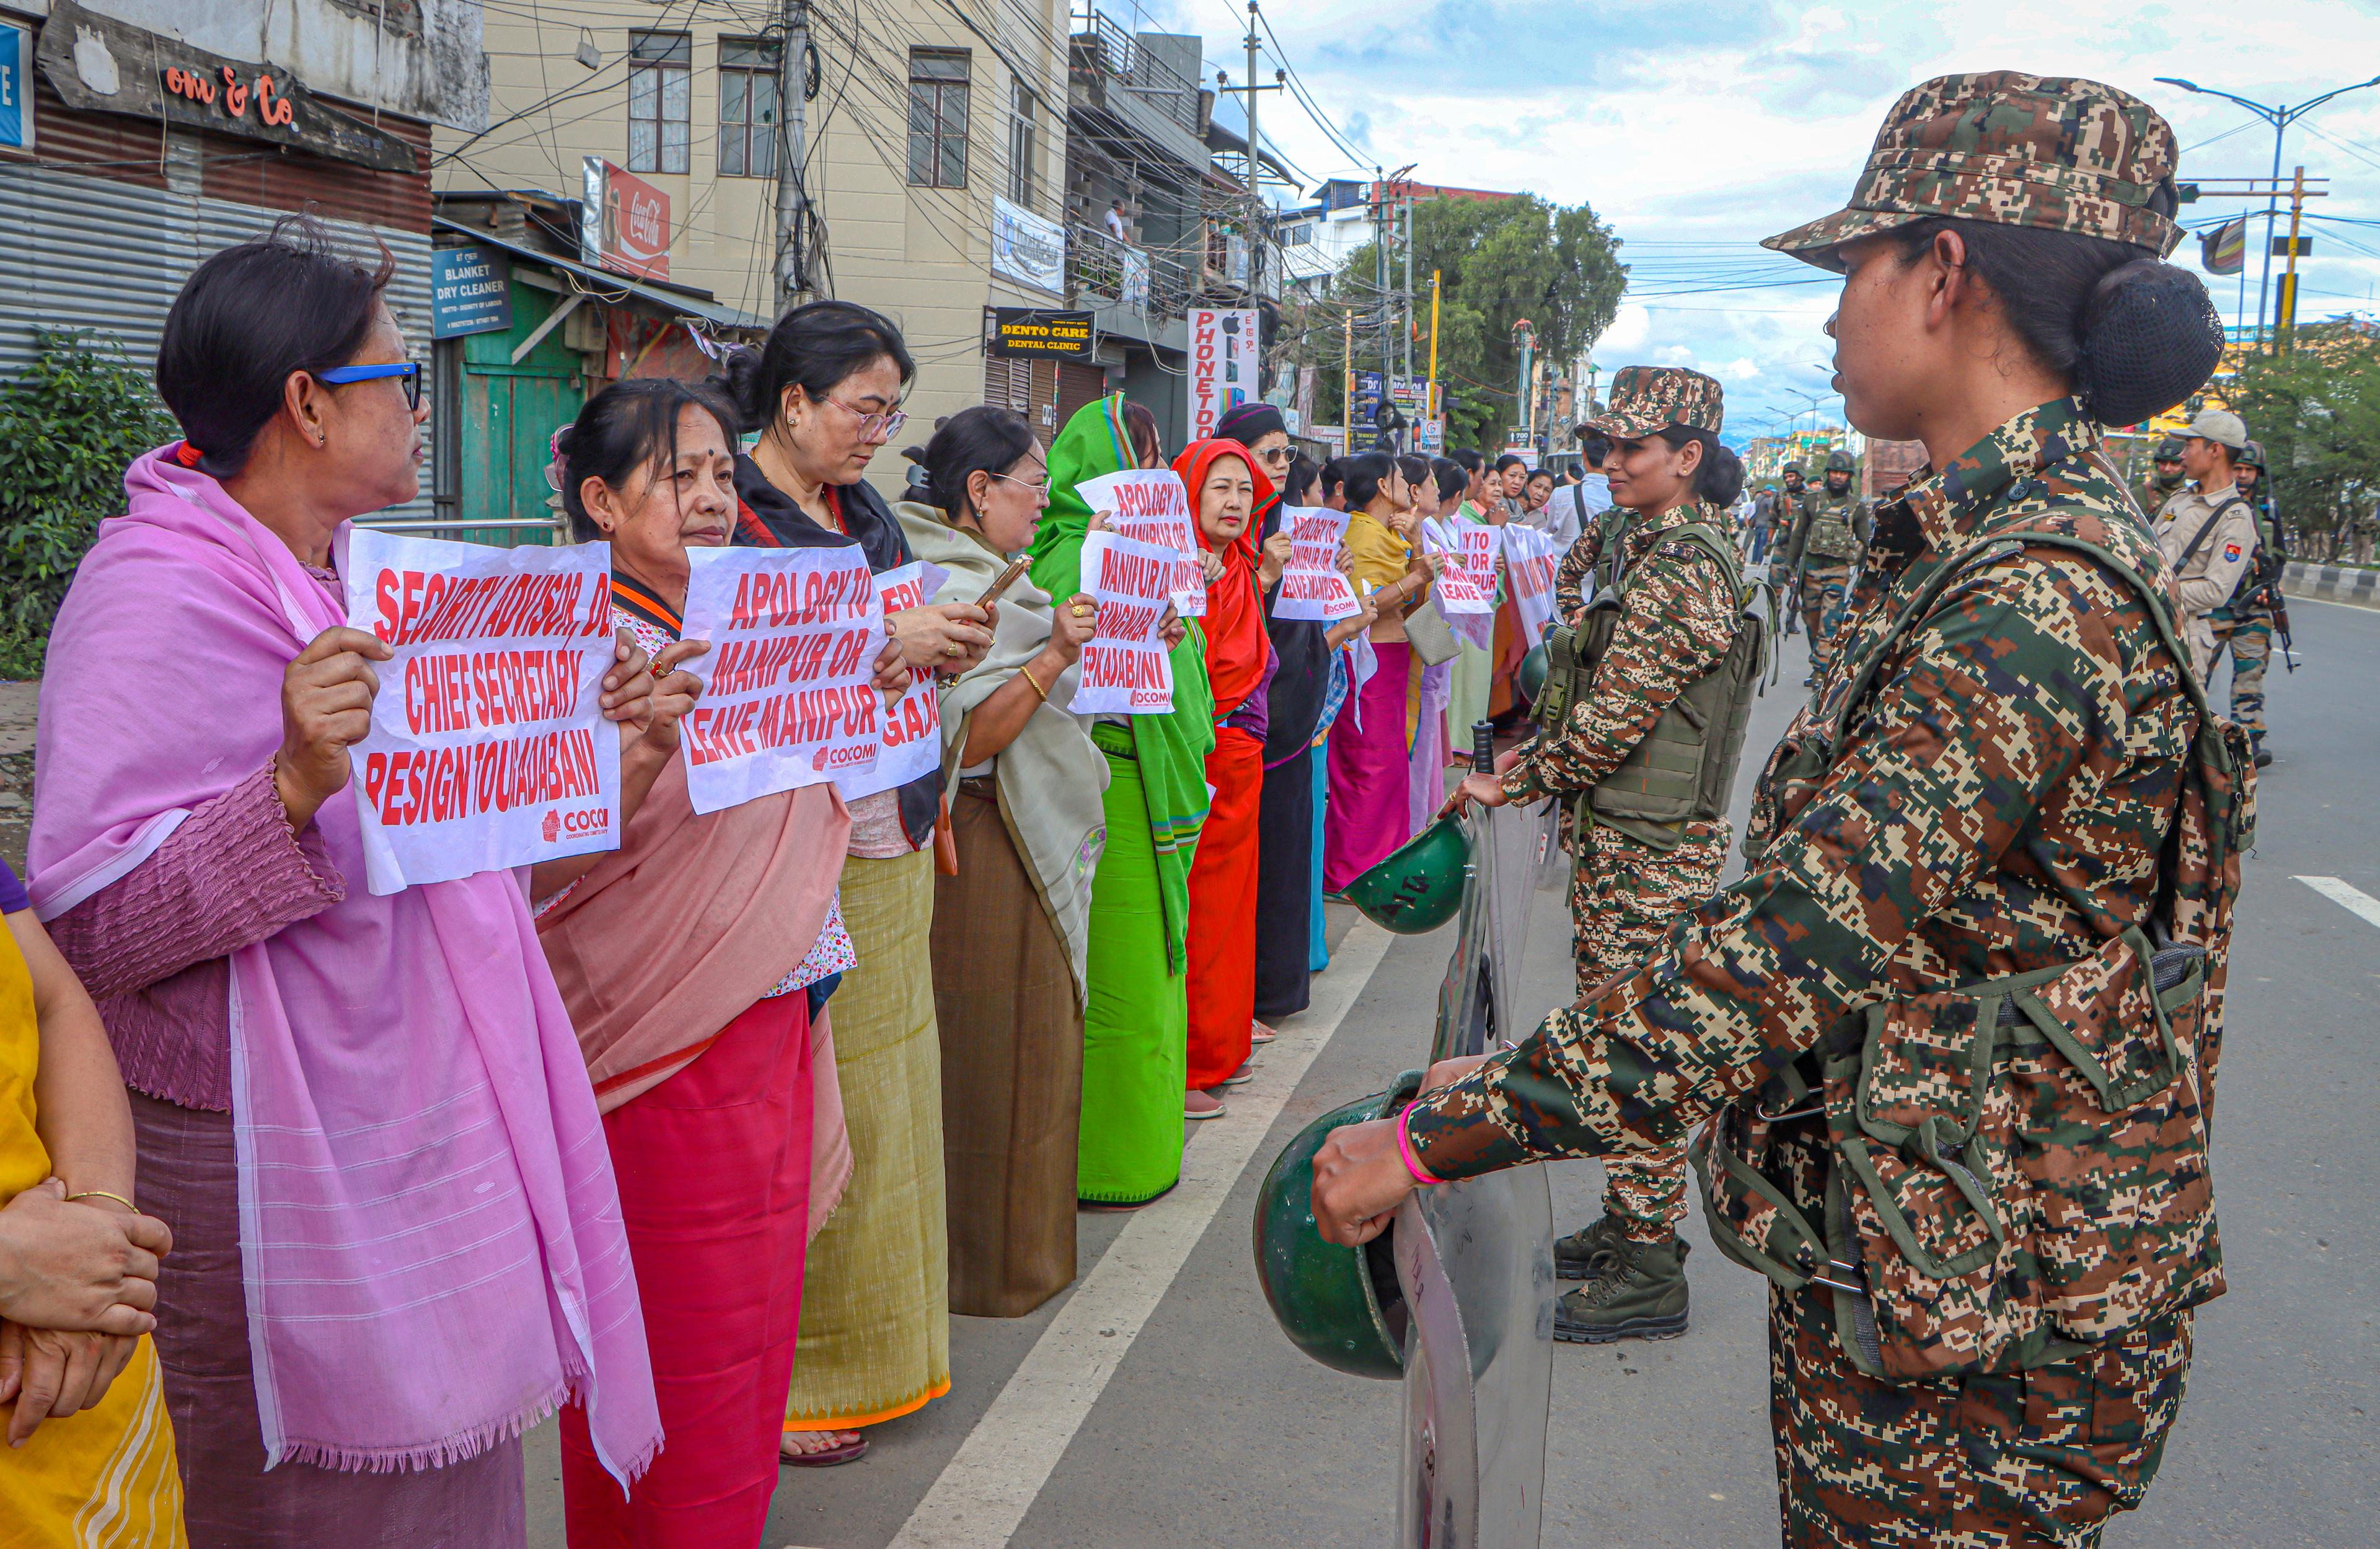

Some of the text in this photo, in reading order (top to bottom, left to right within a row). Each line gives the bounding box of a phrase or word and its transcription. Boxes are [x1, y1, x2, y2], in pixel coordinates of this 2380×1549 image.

[444, 264, 490, 281] BLANKET
[437, 280, 505, 300] DRY CLEANER
[1001, 324, 1089, 338] DENTO CARE
[1007, 340, 1081, 351] DENTAL CLINIC
[1113, 483, 1184, 517] APOLOGY TO
[1172, 522, 1190, 554] OR
[1291, 515, 1339, 544] APOLOGY TO
[1474, 532, 1489, 550] TO
[1099, 547, 1160, 599] MANIPUR
[1320, 549, 1333, 573] OR
[1471, 553, 1490, 571] OR
[728, 566, 871, 631] APOLOGY TO
[1438, 584, 1479, 601] LEAVE
[708, 628, 869, 697] MANIPUR OR
[405, 650, 584, 736] CHIEF SECRETARY
[680, 684, 877, 766] LEAVE MANIPUR
[830, 743, 877, 764] COCOMI
[365, 746, 472, 826] RESIGN
